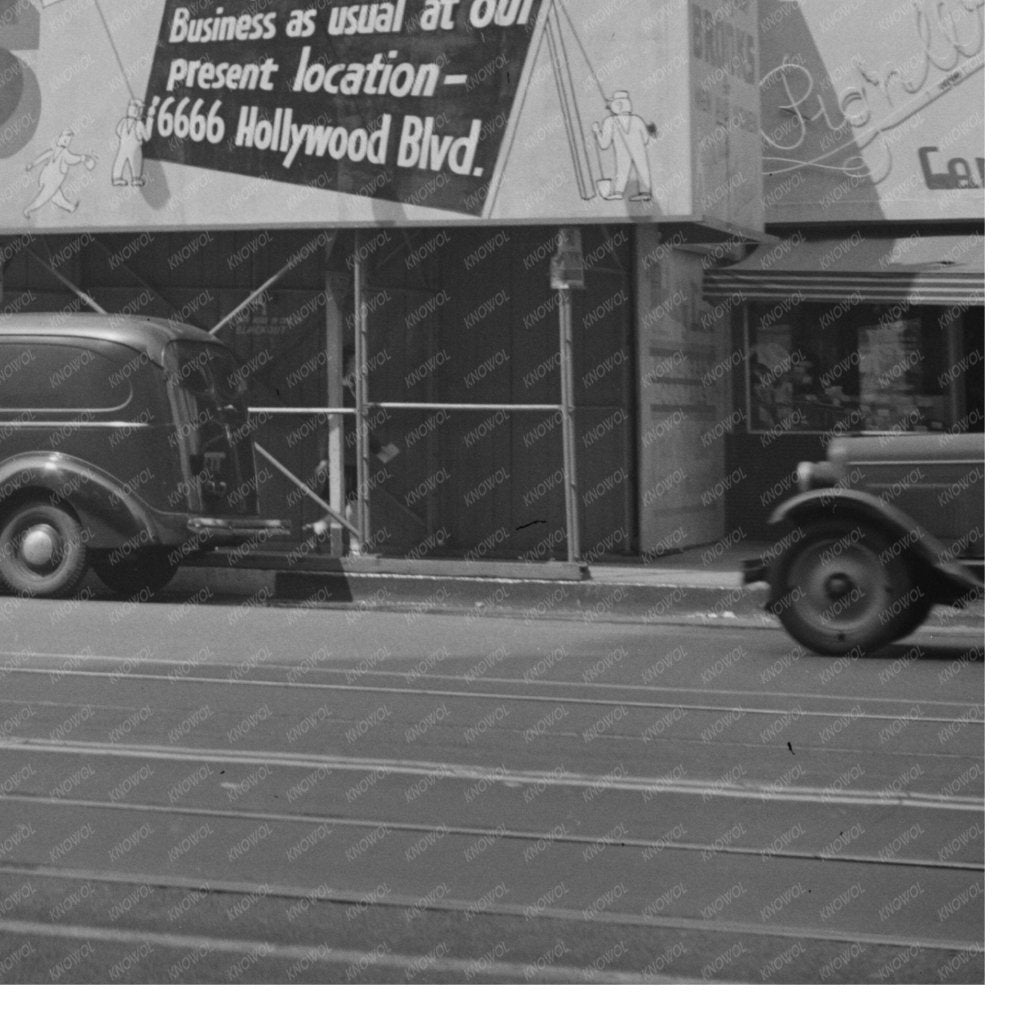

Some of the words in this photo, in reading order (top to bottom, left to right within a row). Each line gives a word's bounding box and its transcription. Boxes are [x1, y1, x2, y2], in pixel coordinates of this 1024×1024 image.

[169, 6, 276, 43] Business
[286, 8, 317, 37] as
[166, 57, 279, 92] present
[235, 105, 392, 169] Hollywood
[396, 114, 484, 176] Blvd.
